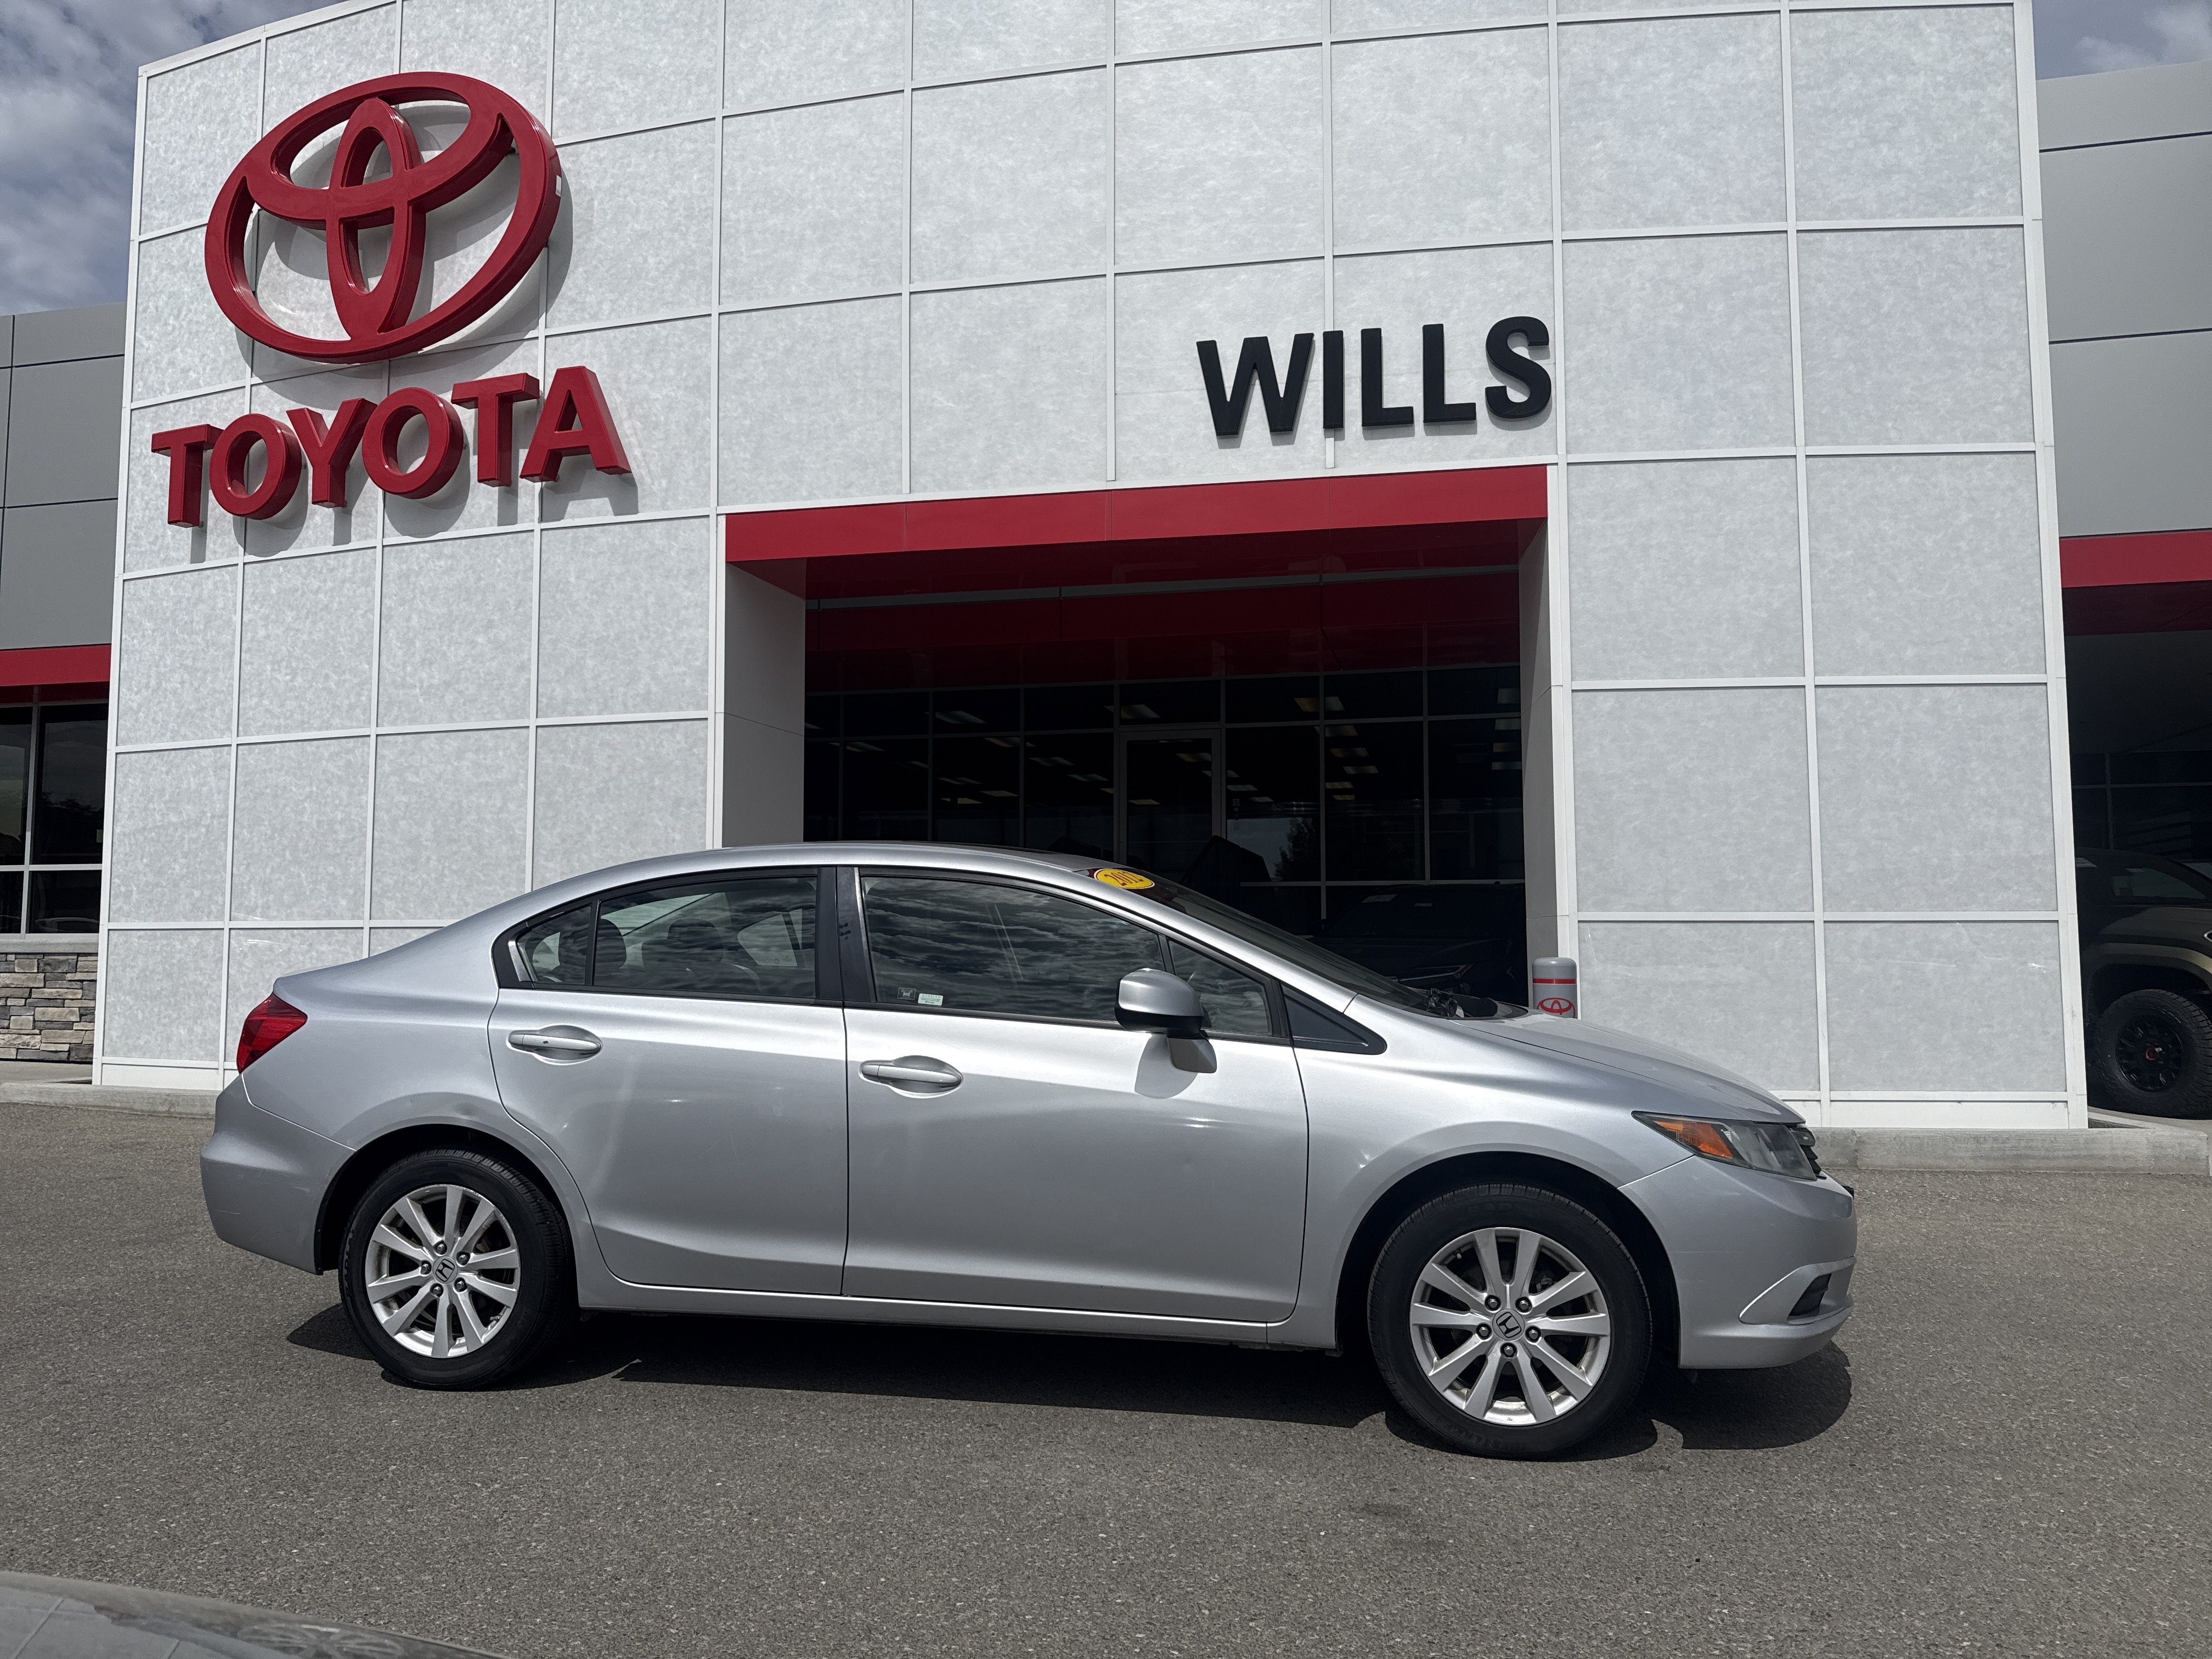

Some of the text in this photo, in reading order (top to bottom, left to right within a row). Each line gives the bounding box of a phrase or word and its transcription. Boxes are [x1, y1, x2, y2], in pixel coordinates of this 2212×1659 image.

[1197, 316, 1552, 436] WILLS
[151, 365, 631, 527] TOYOTA
[1104, 871, 1144, 886] 2012
